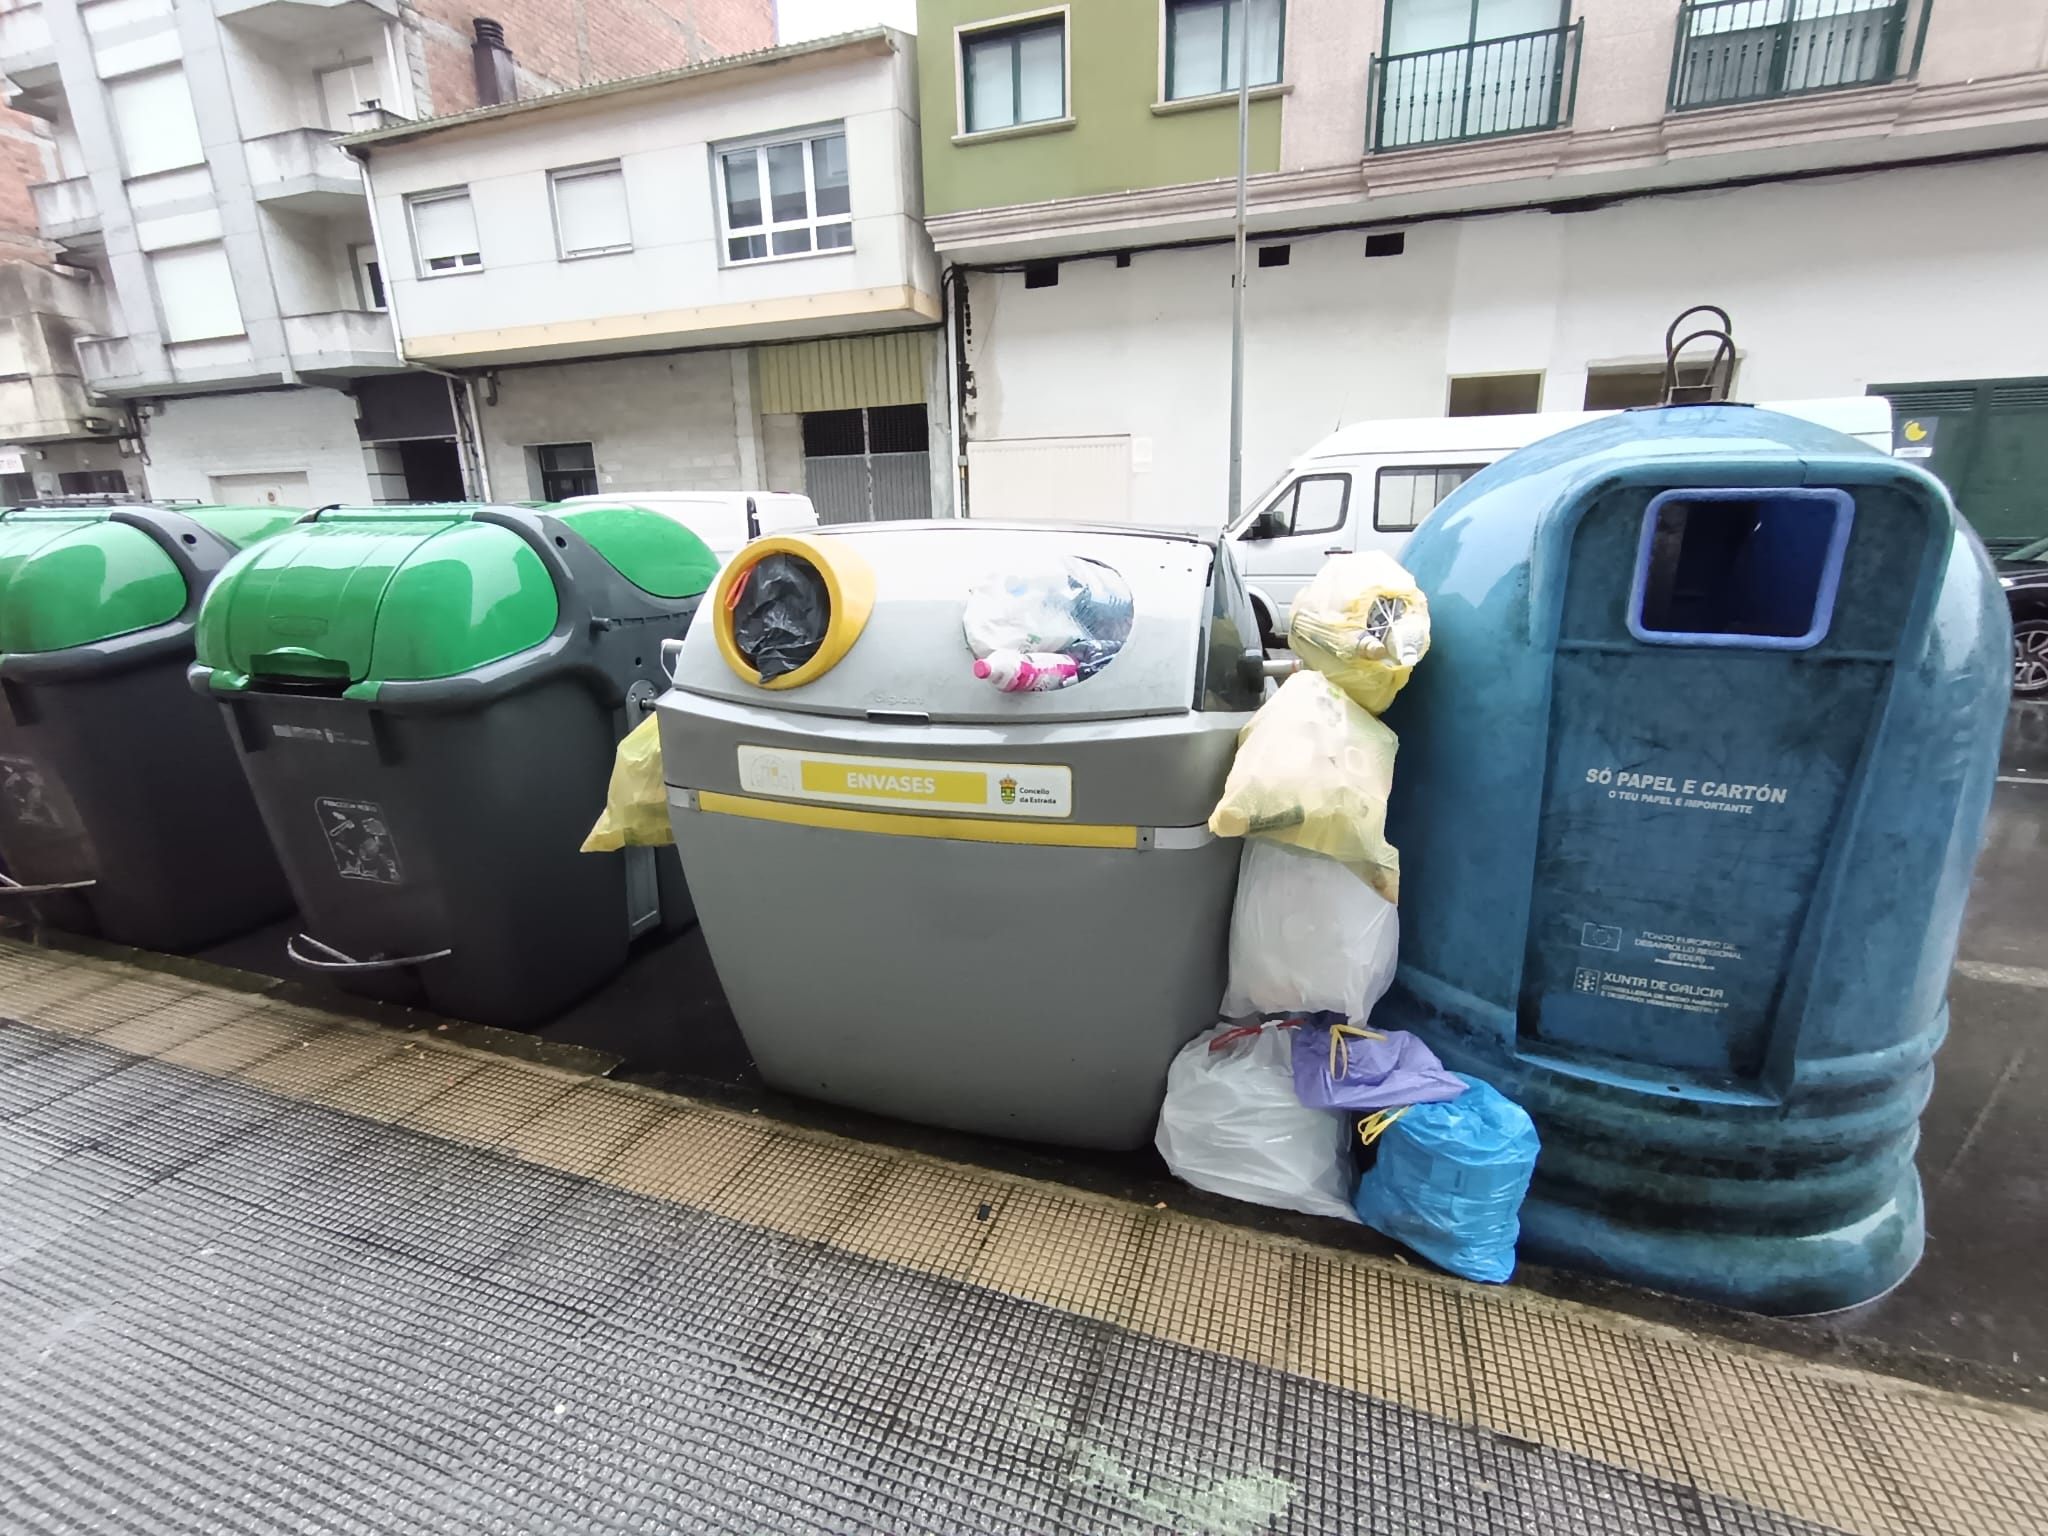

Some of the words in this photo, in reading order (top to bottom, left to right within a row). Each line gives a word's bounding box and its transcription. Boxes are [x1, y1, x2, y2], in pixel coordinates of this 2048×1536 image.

[847, 772, 935, 795] ENVASES
[1019, 787, 1050, 795] Concello
[1586, 768, 1612, 785] SÓ
[1616, 771, 1676, 793] PAPEL
[1682, 779, 1697, 794] E
[1701, 782, 1788, 803] CARTÓN
[1608, 790, 1616, 799] O
[1619, 791, 1639, 801] TEU
[1641, 794, 1673, 806] PAPEL
[1684, 799, 1753, 814] IMPORTANTE
[1603, 972, 1648, 988] XUNTA
[1650, 979, 1668, 991] DE
[1669, 983, 1724, 998] GALICIA
